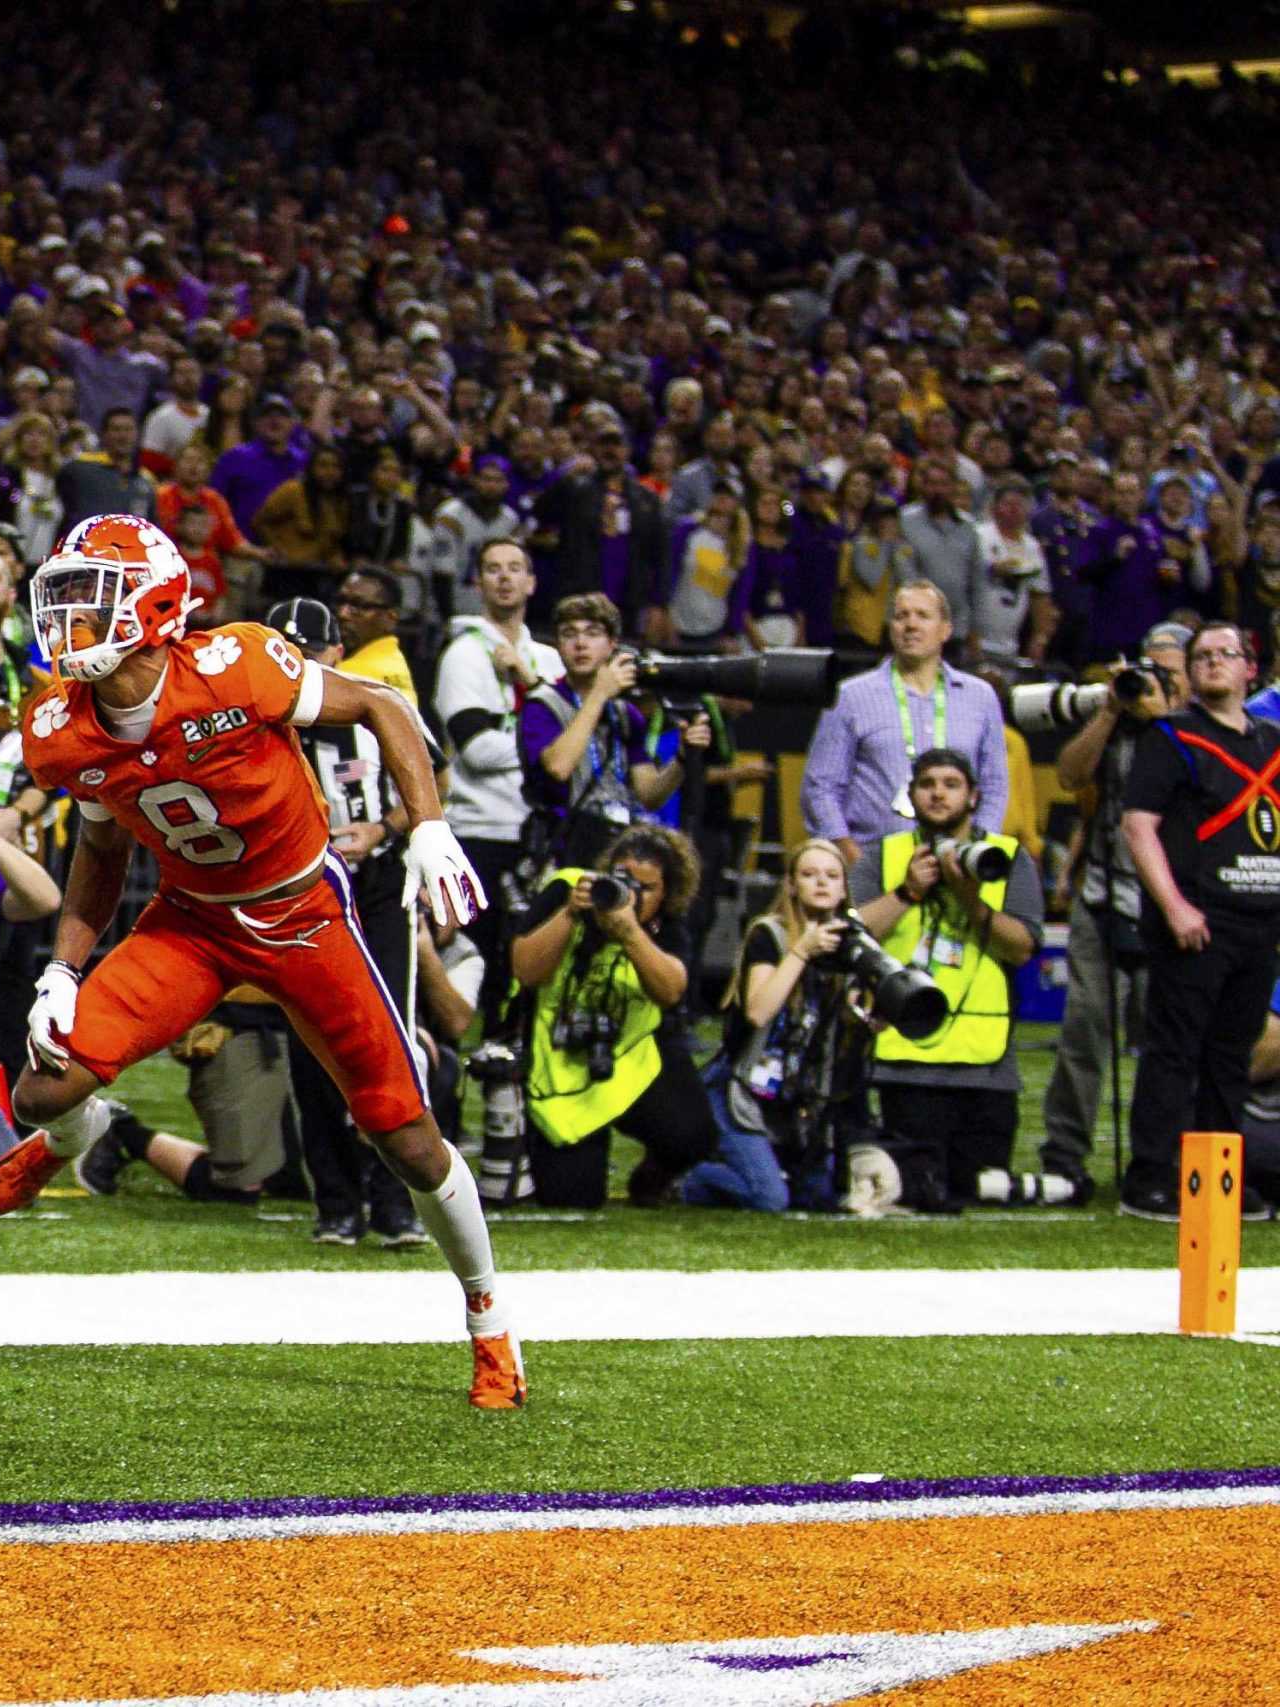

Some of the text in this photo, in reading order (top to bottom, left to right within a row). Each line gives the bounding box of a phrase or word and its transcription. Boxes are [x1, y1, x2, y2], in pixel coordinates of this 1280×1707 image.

[265, 637, 303, 680] 8
[181, 707, 248, 743] 2020
[138, 780, 246, 864] 8
